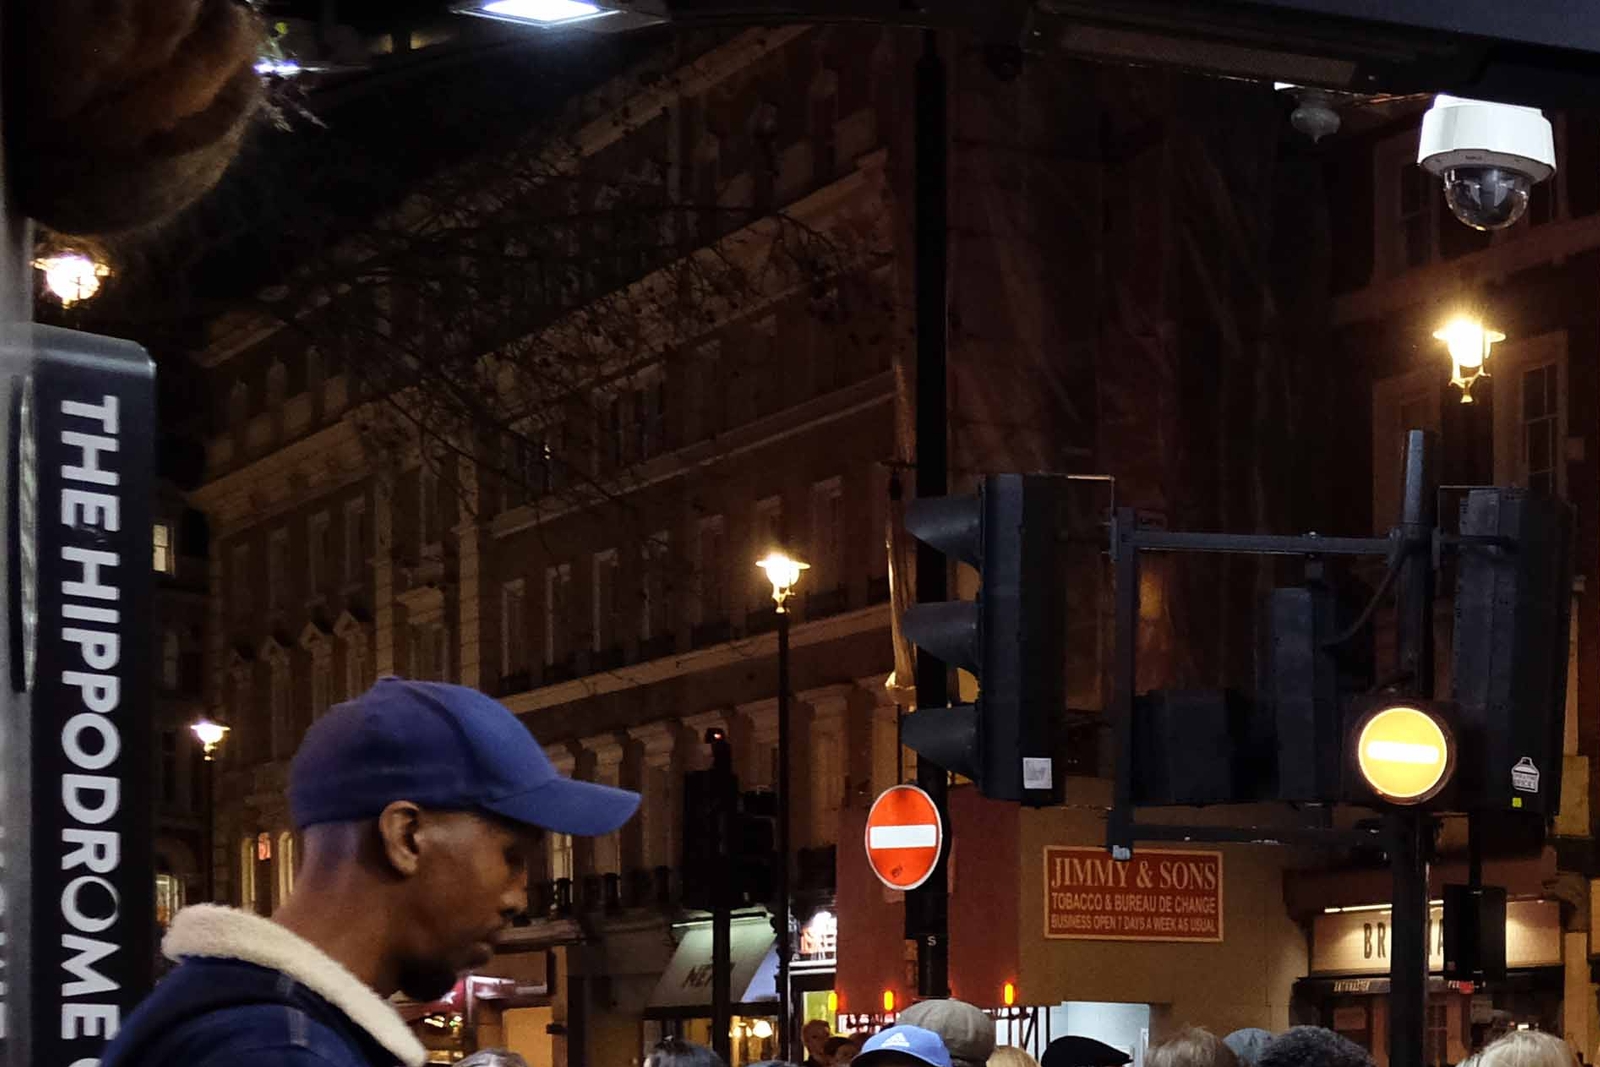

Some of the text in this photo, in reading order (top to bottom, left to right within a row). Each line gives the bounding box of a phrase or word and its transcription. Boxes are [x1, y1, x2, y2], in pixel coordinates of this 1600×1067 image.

[60, 394, 120, 533] THE
[60, 546, 122, 1041] HIPPODROME
[1051, 857, 1217, 890] JIMMY & SONS
[1051, 892, 1216, 914] TOBACCO & BUREAU DE CHANGE
[1051, 913, 1217, 932] BUSINESS OPEN 7 DAYS A WEEK AS USUAL
[926, 935, 937, 947] S
